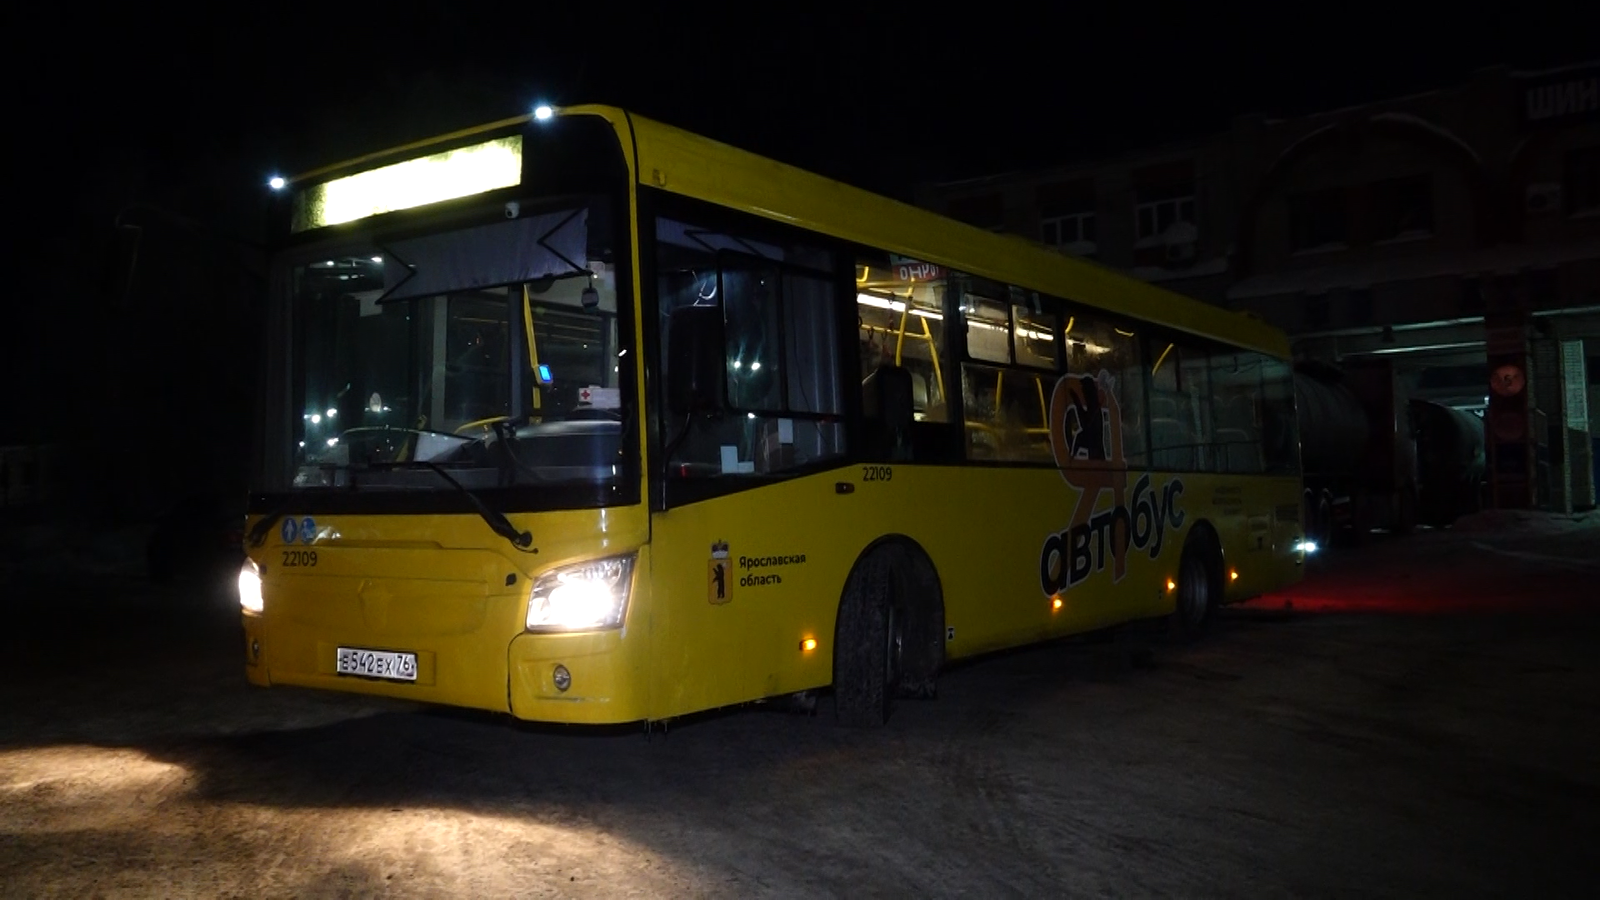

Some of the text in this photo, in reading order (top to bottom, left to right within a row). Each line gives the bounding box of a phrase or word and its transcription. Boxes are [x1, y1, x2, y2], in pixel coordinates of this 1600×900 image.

[862, 466, 892, 481] 22109
[1040, 474, 1186, 596] автобус
[282, 551, 317, 566] 22109
[739, 554, 806, 571] Ярославская
[739, 573, 782, 587] область
